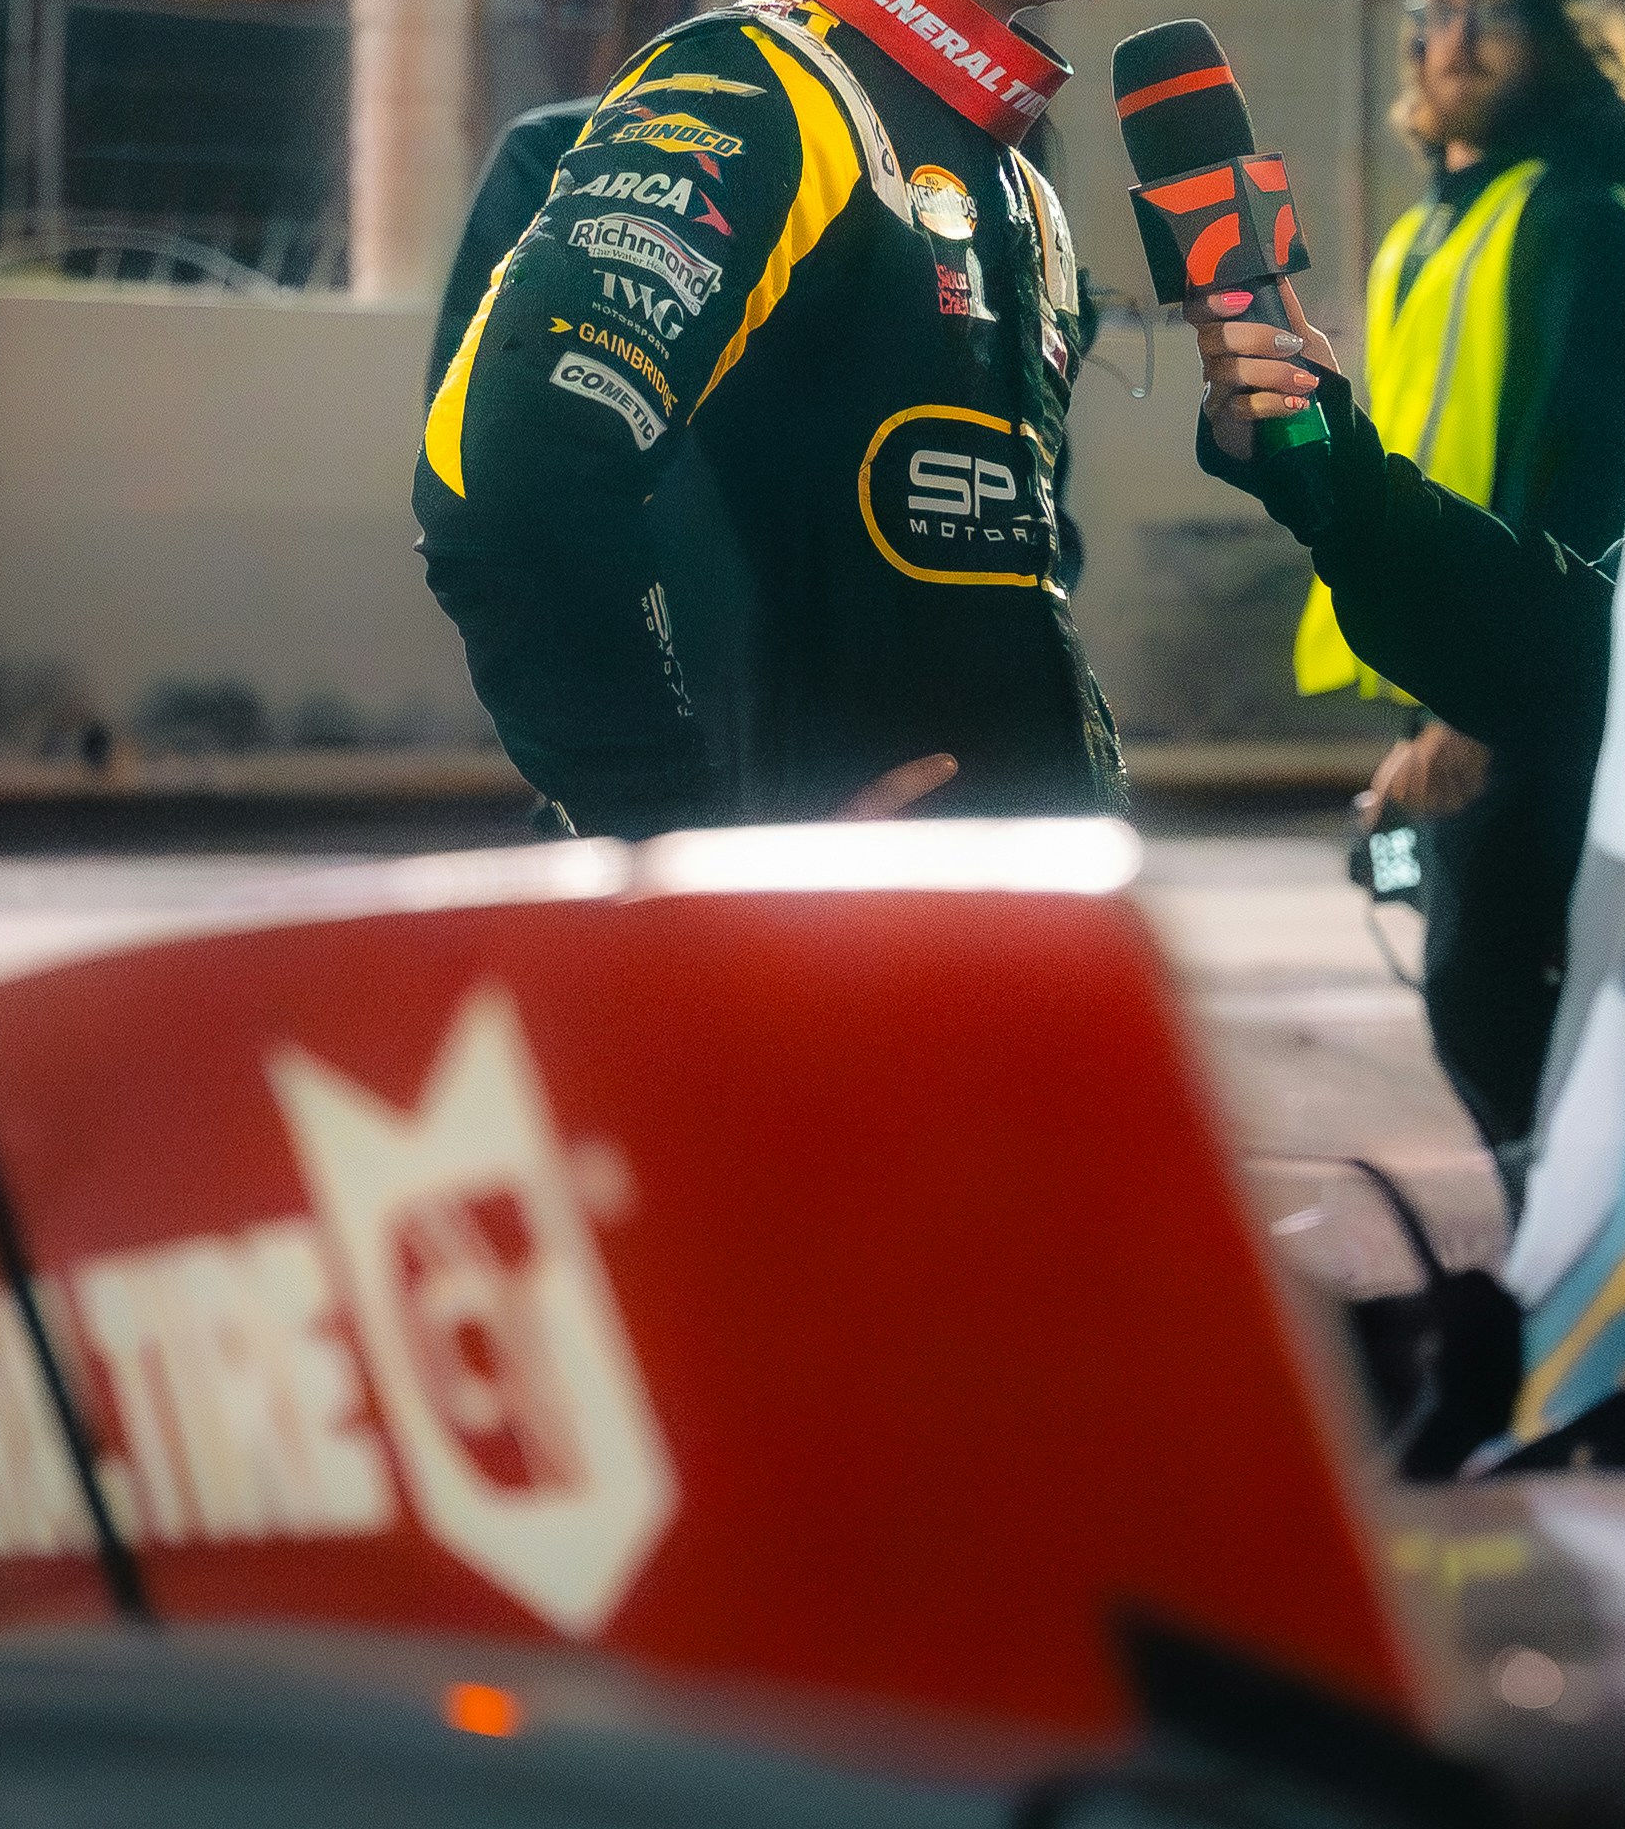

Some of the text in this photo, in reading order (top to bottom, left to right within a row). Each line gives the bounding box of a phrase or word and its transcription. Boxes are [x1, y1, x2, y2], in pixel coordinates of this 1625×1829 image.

[623, 123, 736, 156] SUNOCO
[572, 172, 694, 216] ARCA
[574, 222, 720, 298] Richmond
[591, 301, 671, 361] MOTORSPORTS
[593, 269, 684, 341] TWG
[560, 365, 655, 441] COMETIC
[578, 322, 679, 418] GAINBRIDGE
[907, 449, 1017, 519] SP
